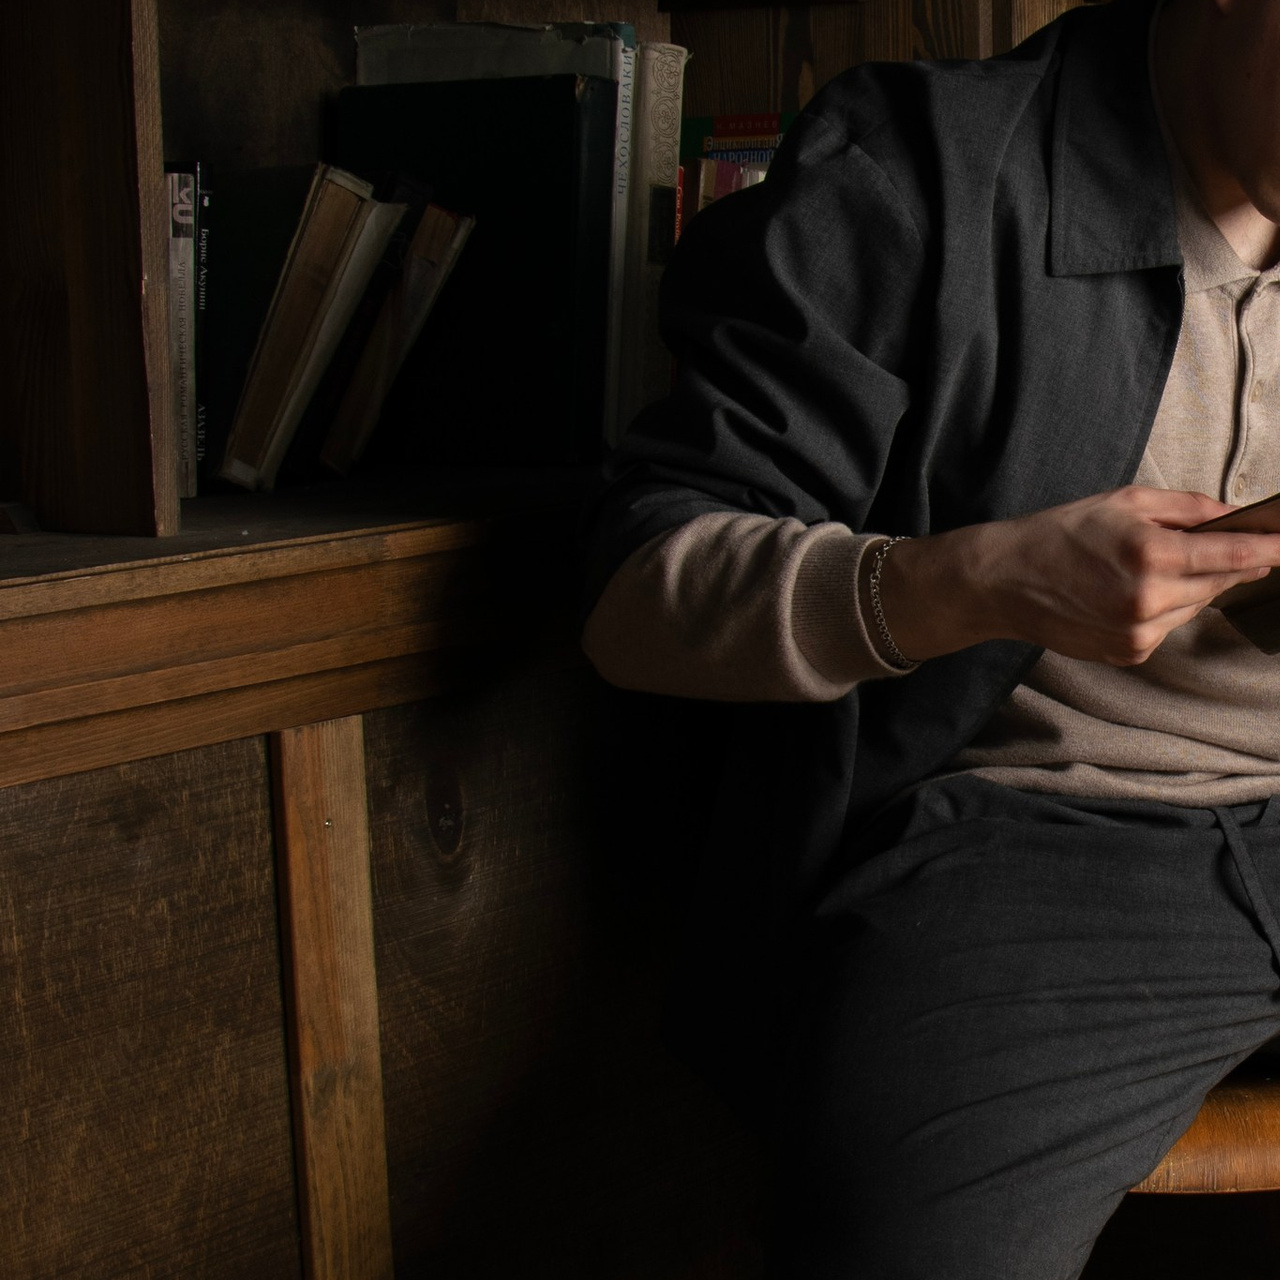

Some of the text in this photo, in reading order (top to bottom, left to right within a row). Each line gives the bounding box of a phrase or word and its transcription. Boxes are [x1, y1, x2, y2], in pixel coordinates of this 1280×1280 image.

[617, 54, 633, 195] ЧЕХОСЛОВАКИ
[197, 228, 209, 309] Борис Акунин
[177, 261, 188, 459] РУССКАЯ РОМАНТИЧЕСКАЯ НОВЕЛЛА
[196, 403, 205, 461] АЗАЗЕЛЬ
